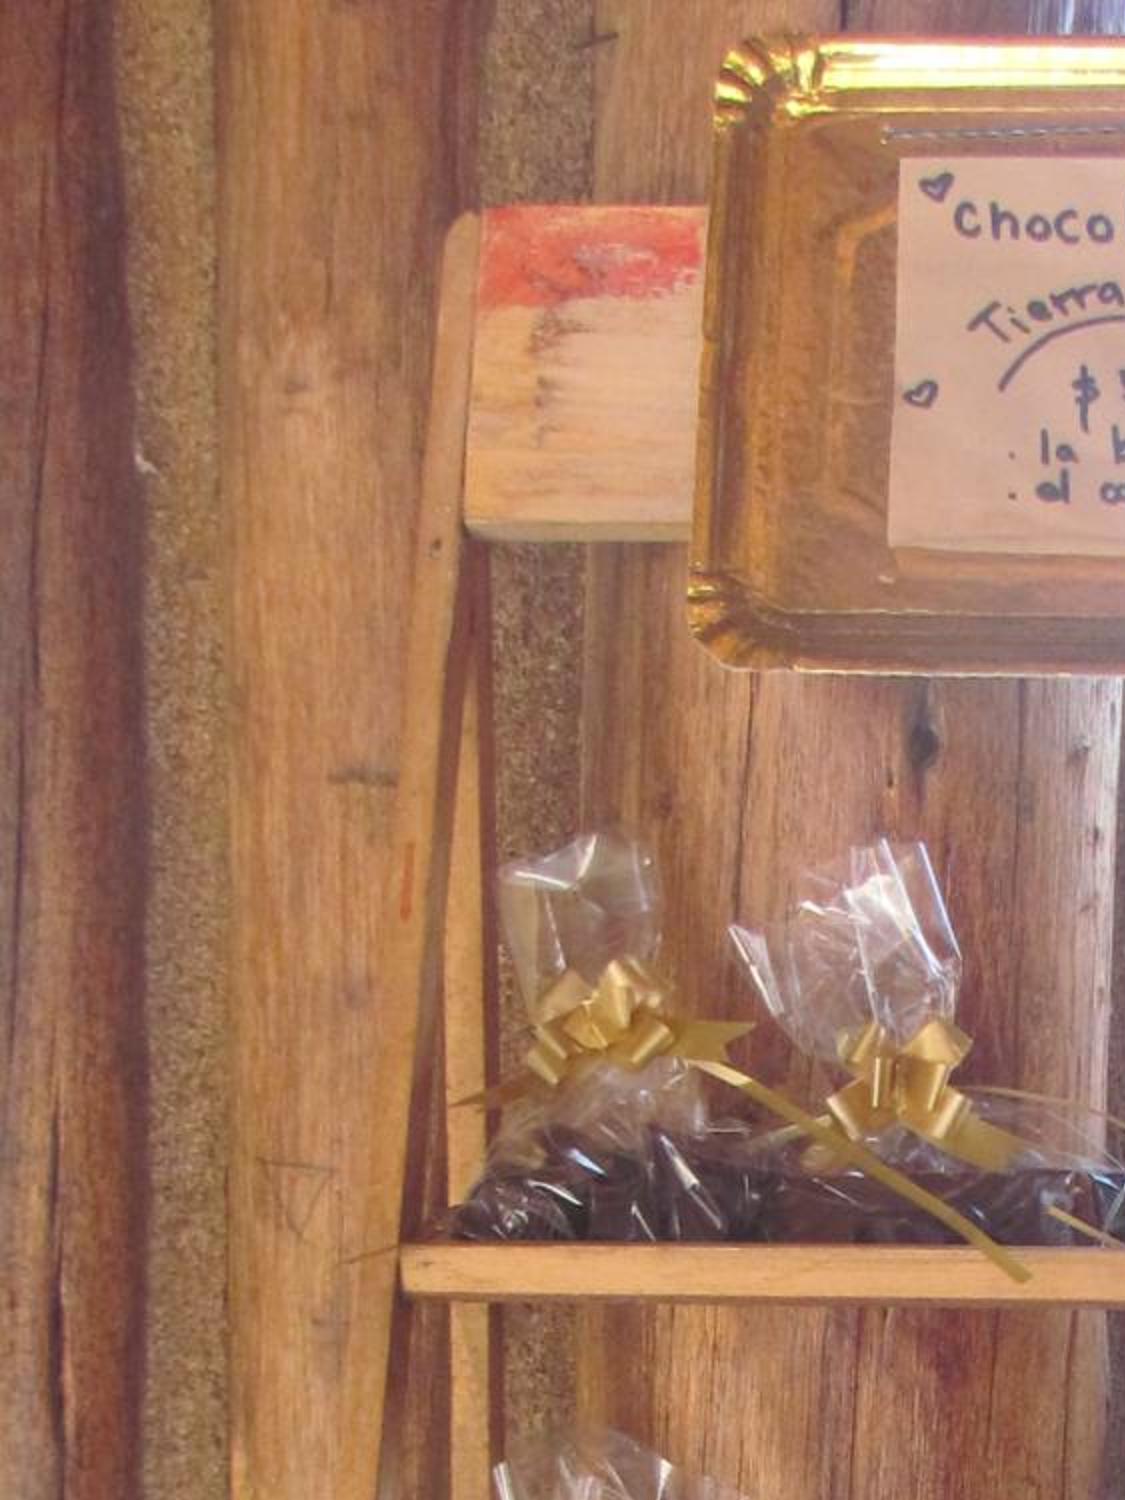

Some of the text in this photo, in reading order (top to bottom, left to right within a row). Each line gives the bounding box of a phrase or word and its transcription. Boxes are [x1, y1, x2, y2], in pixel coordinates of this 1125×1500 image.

[967, 281, 1125, 343] Tierra
[1041, 429, 1080, 464] la
[1036, 469, 1071, 504] el
